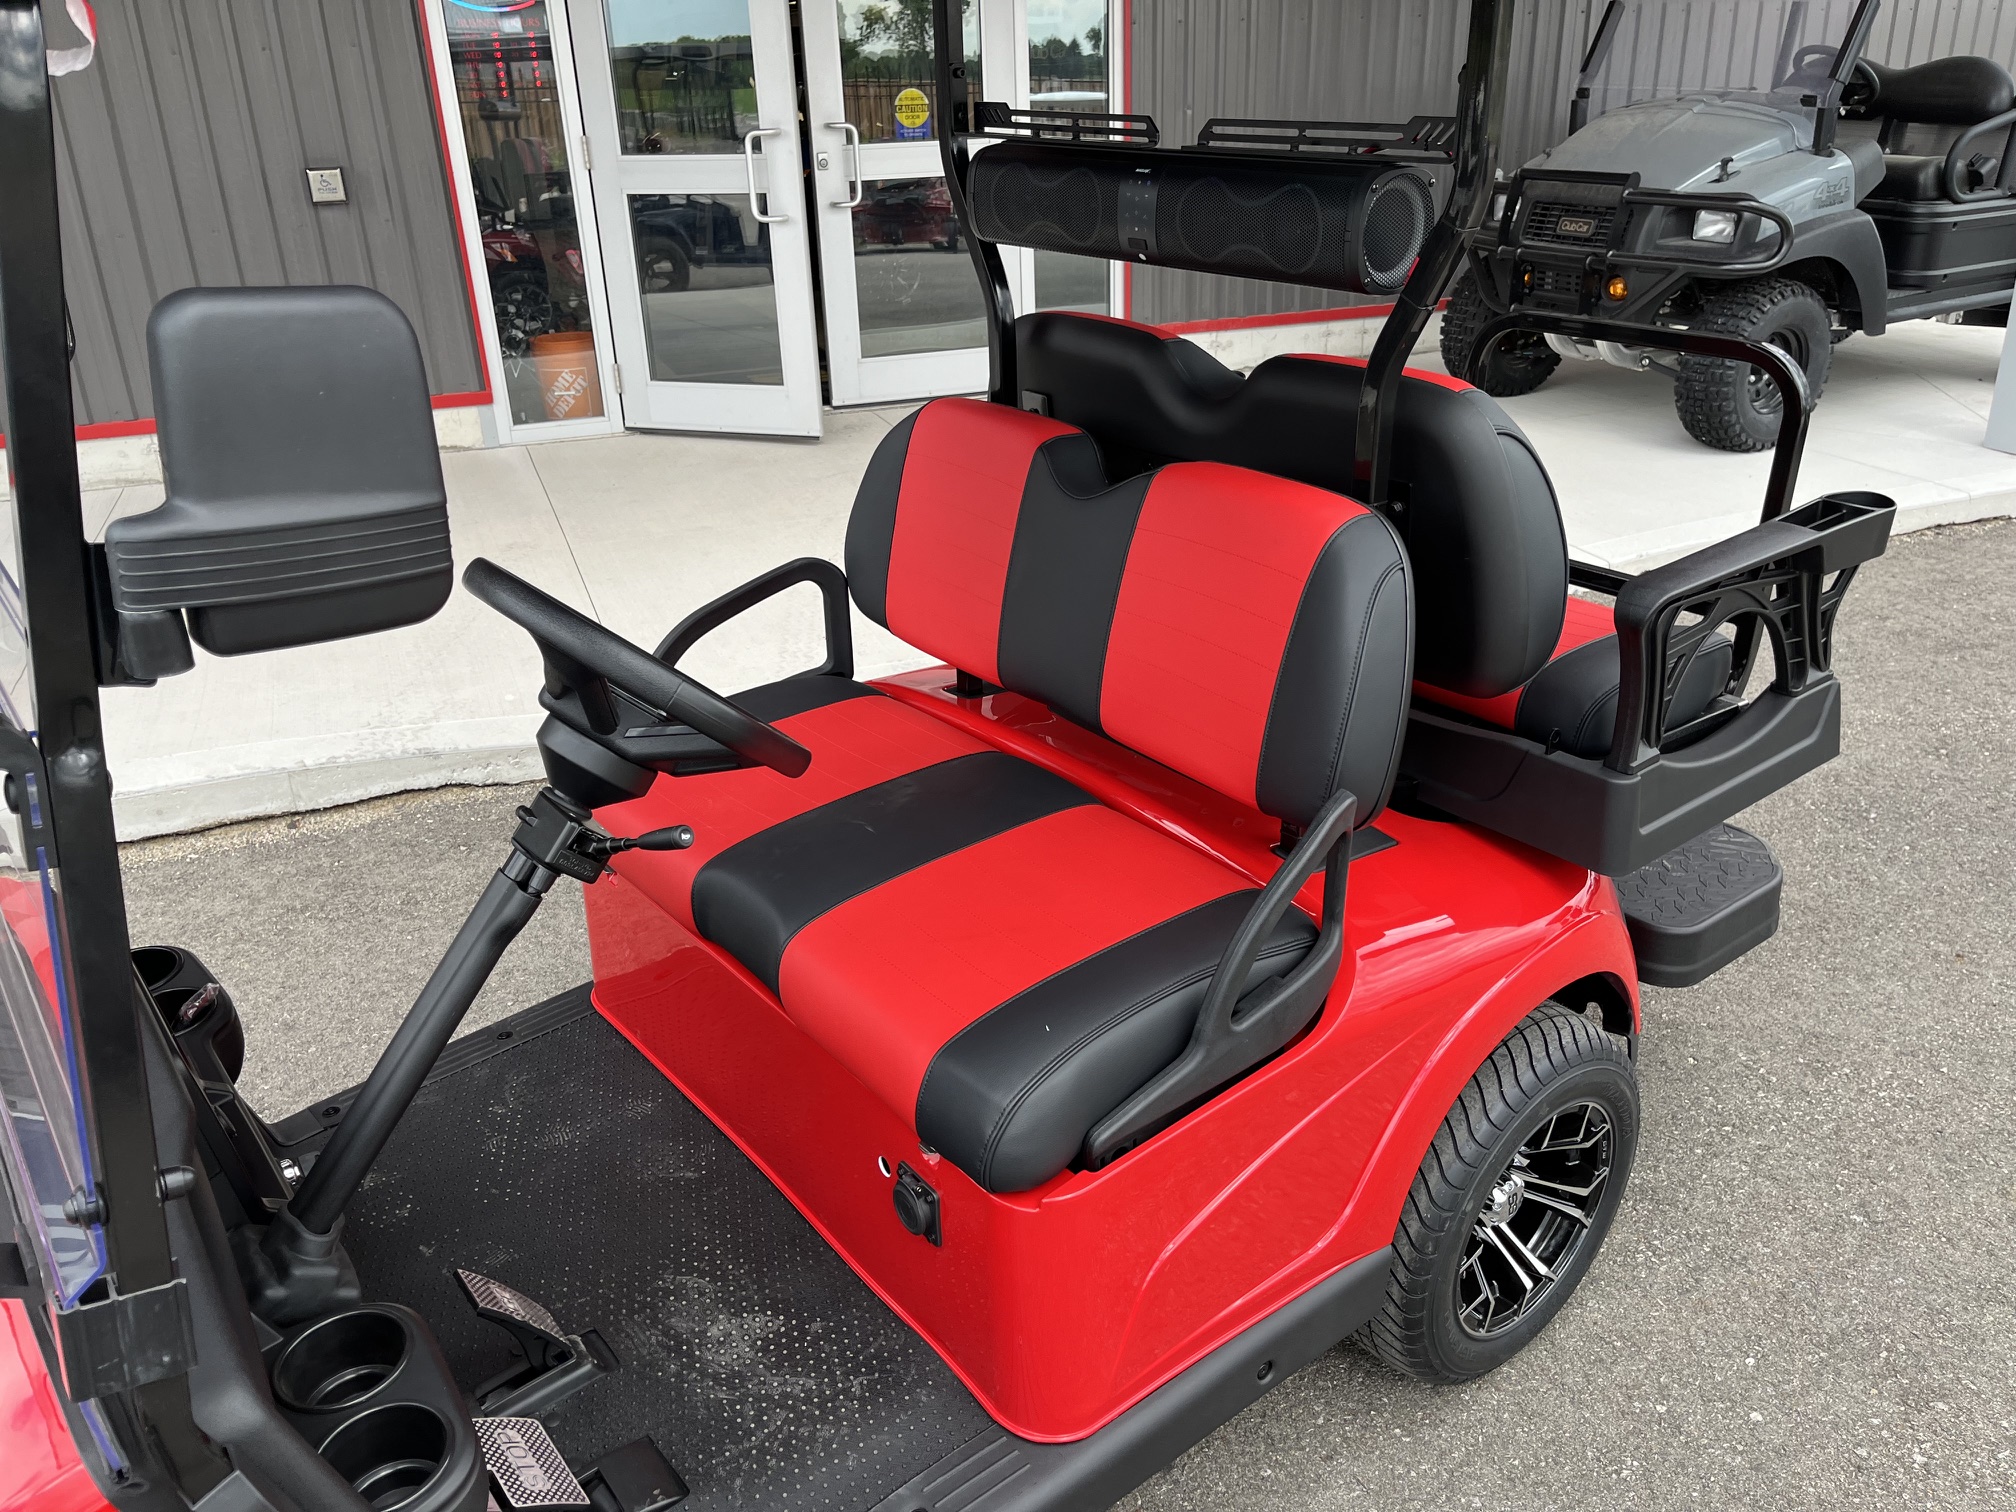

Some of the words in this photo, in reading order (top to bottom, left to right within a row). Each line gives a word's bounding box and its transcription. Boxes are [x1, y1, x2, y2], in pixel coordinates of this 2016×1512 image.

[457, 18, 501, 28] BUSINESS
[463, 51, 482, 59] WED
[896, 104, 928, 113] CAUTION
[1813, 176, 1850, 201] 4x4
[545, 369, 577, 408] HOME
[553, 375, 589, 419] DEPOT
[497, 1430, 547, 1491] STOP
